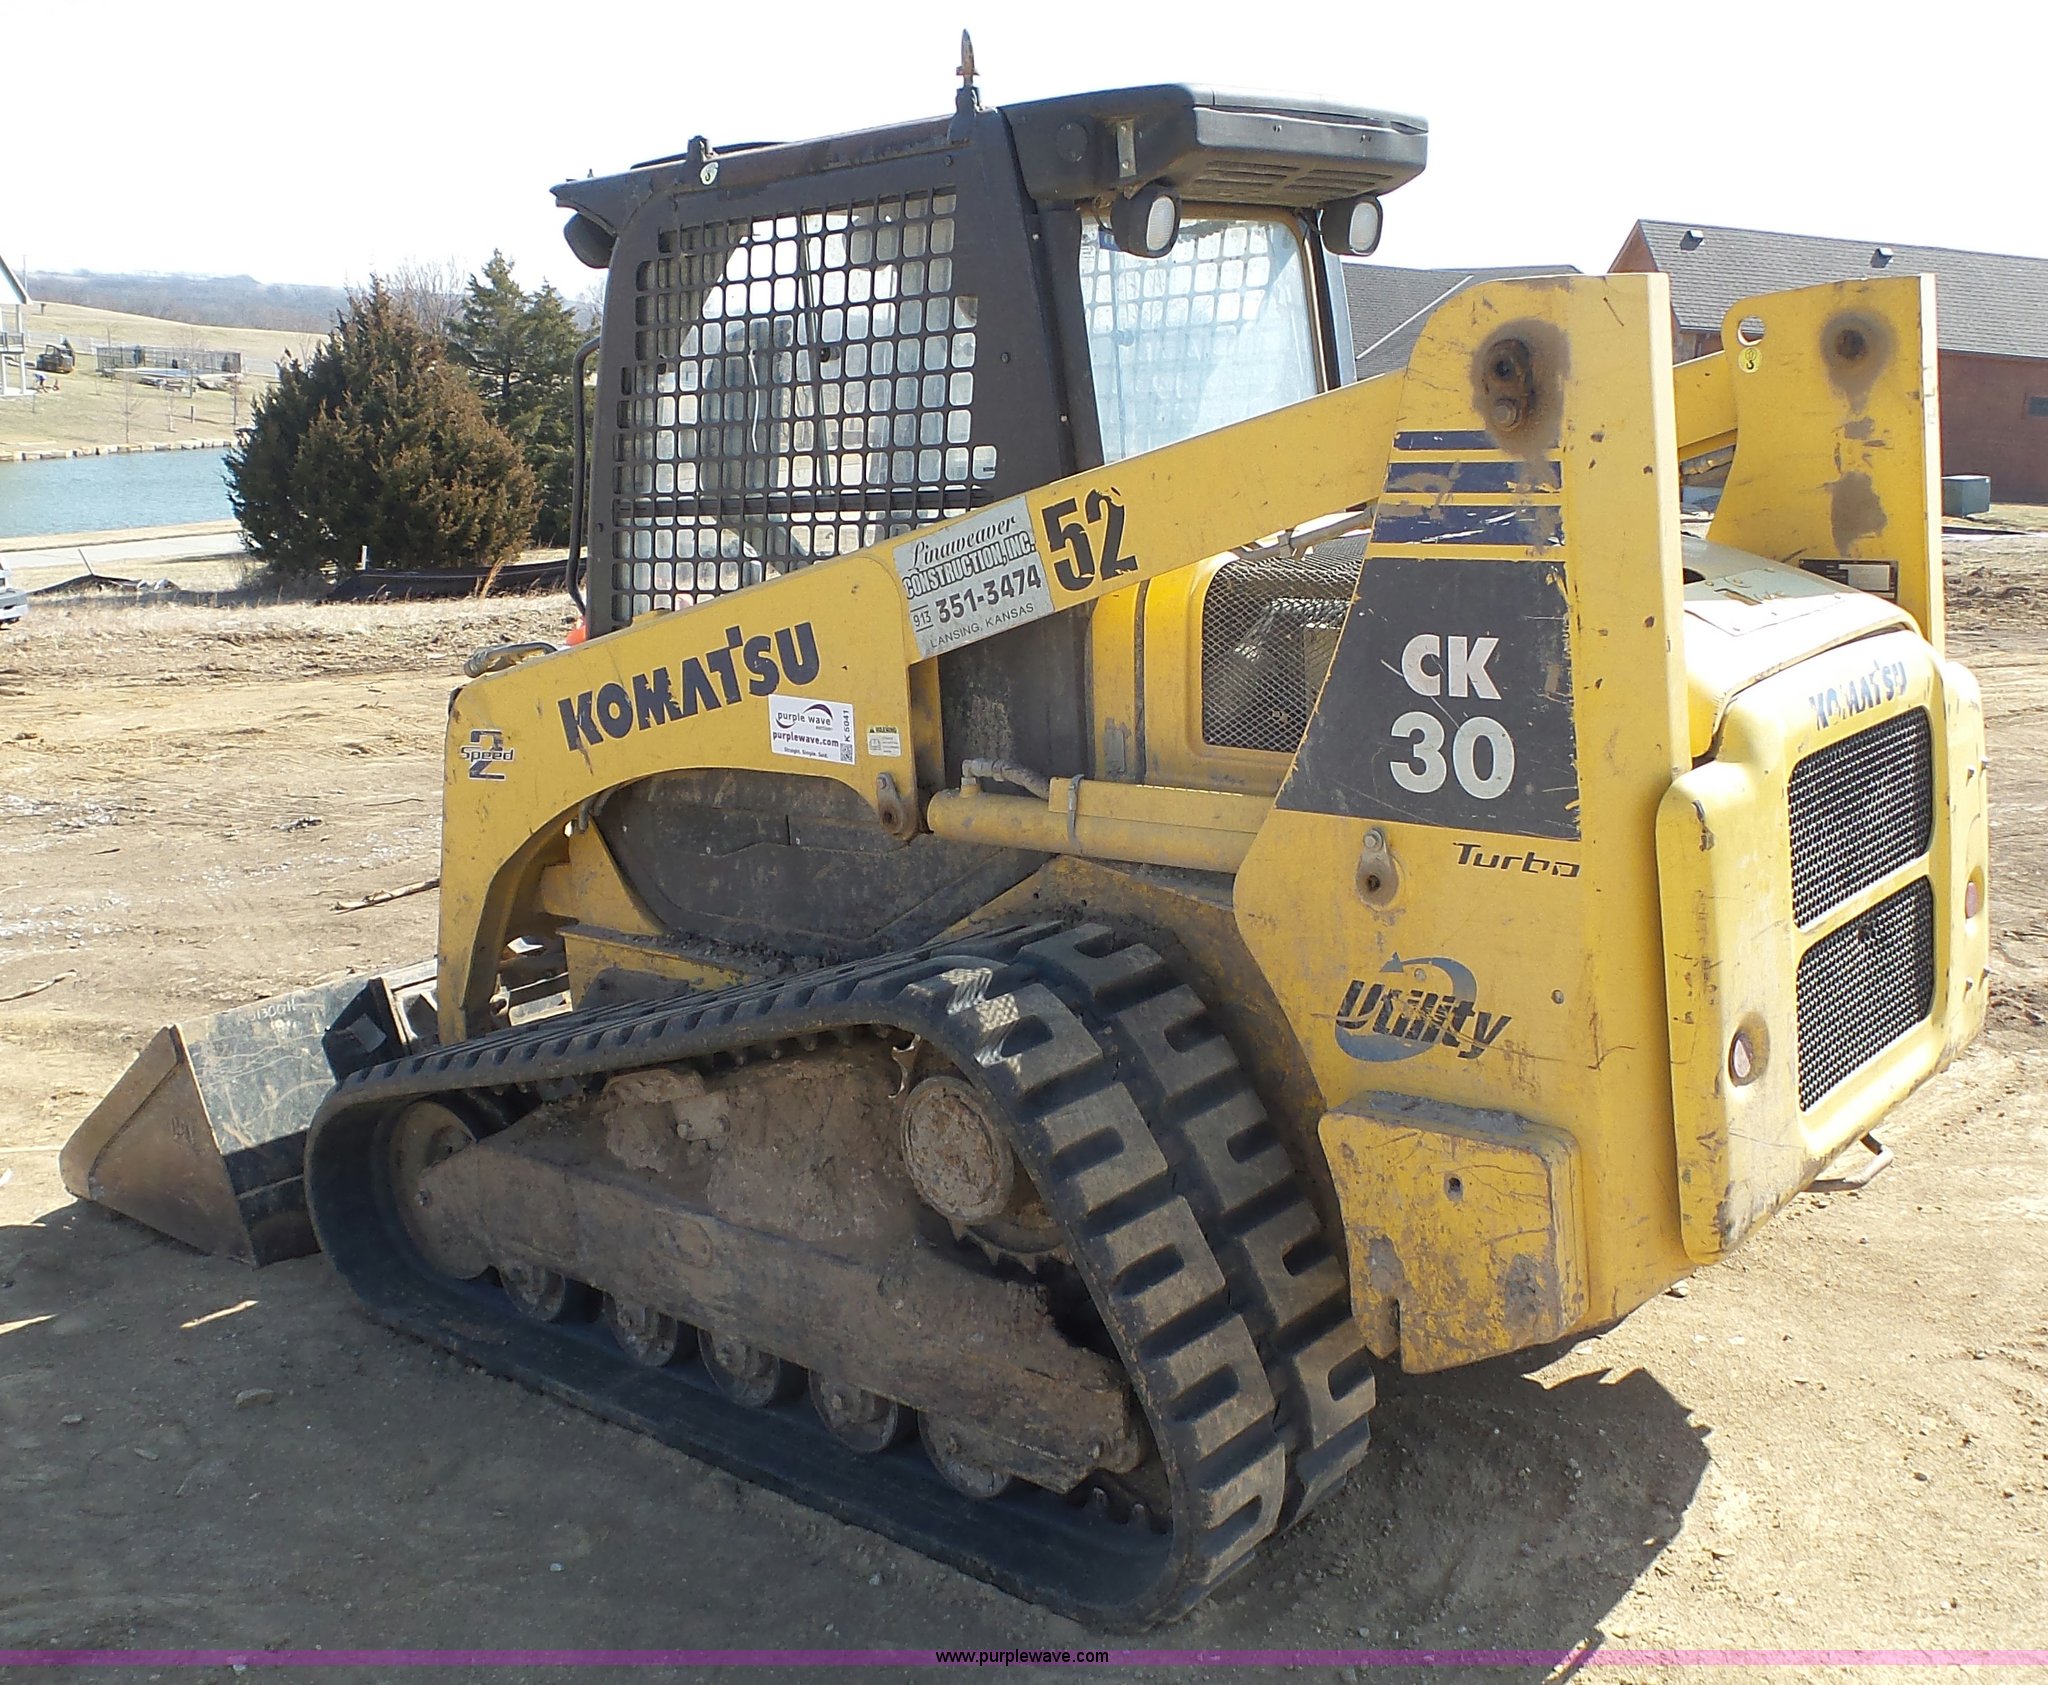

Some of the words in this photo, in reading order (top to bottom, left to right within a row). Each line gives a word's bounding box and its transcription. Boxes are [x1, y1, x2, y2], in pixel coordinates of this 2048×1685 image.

[901, 540, 1008, 600] CONSTRUCTION,
[1002, 530, 1037, 560] INC.
[907, 513, 1017, 572] Linaweaver
[1041, 486, 1139, 592] 52
[912, 609, 932, 627] 913
[935, 564, 1043, 624] 351-3474
[929, 622, 984, 649] LANSING,
[985, 602, 1035, 628] KANSAS
[556, 622, 822, 752] KOMATSU
[1400, 633, 1502, 700] CK
[772, 731, 840, 748] purplewave.com
[777, 711, 806, 723] purple
[807, 715, 832, 726] wave
[842, 709, 851, 733] 5041
[843, 735, 851, 743] K
[459, 744, 516, 763] Speed
[1389, 710, 1516, 800] 30
[1452, 841, 1580, 878] Turbo
[1335, 979, 1512, 1060] Utility
